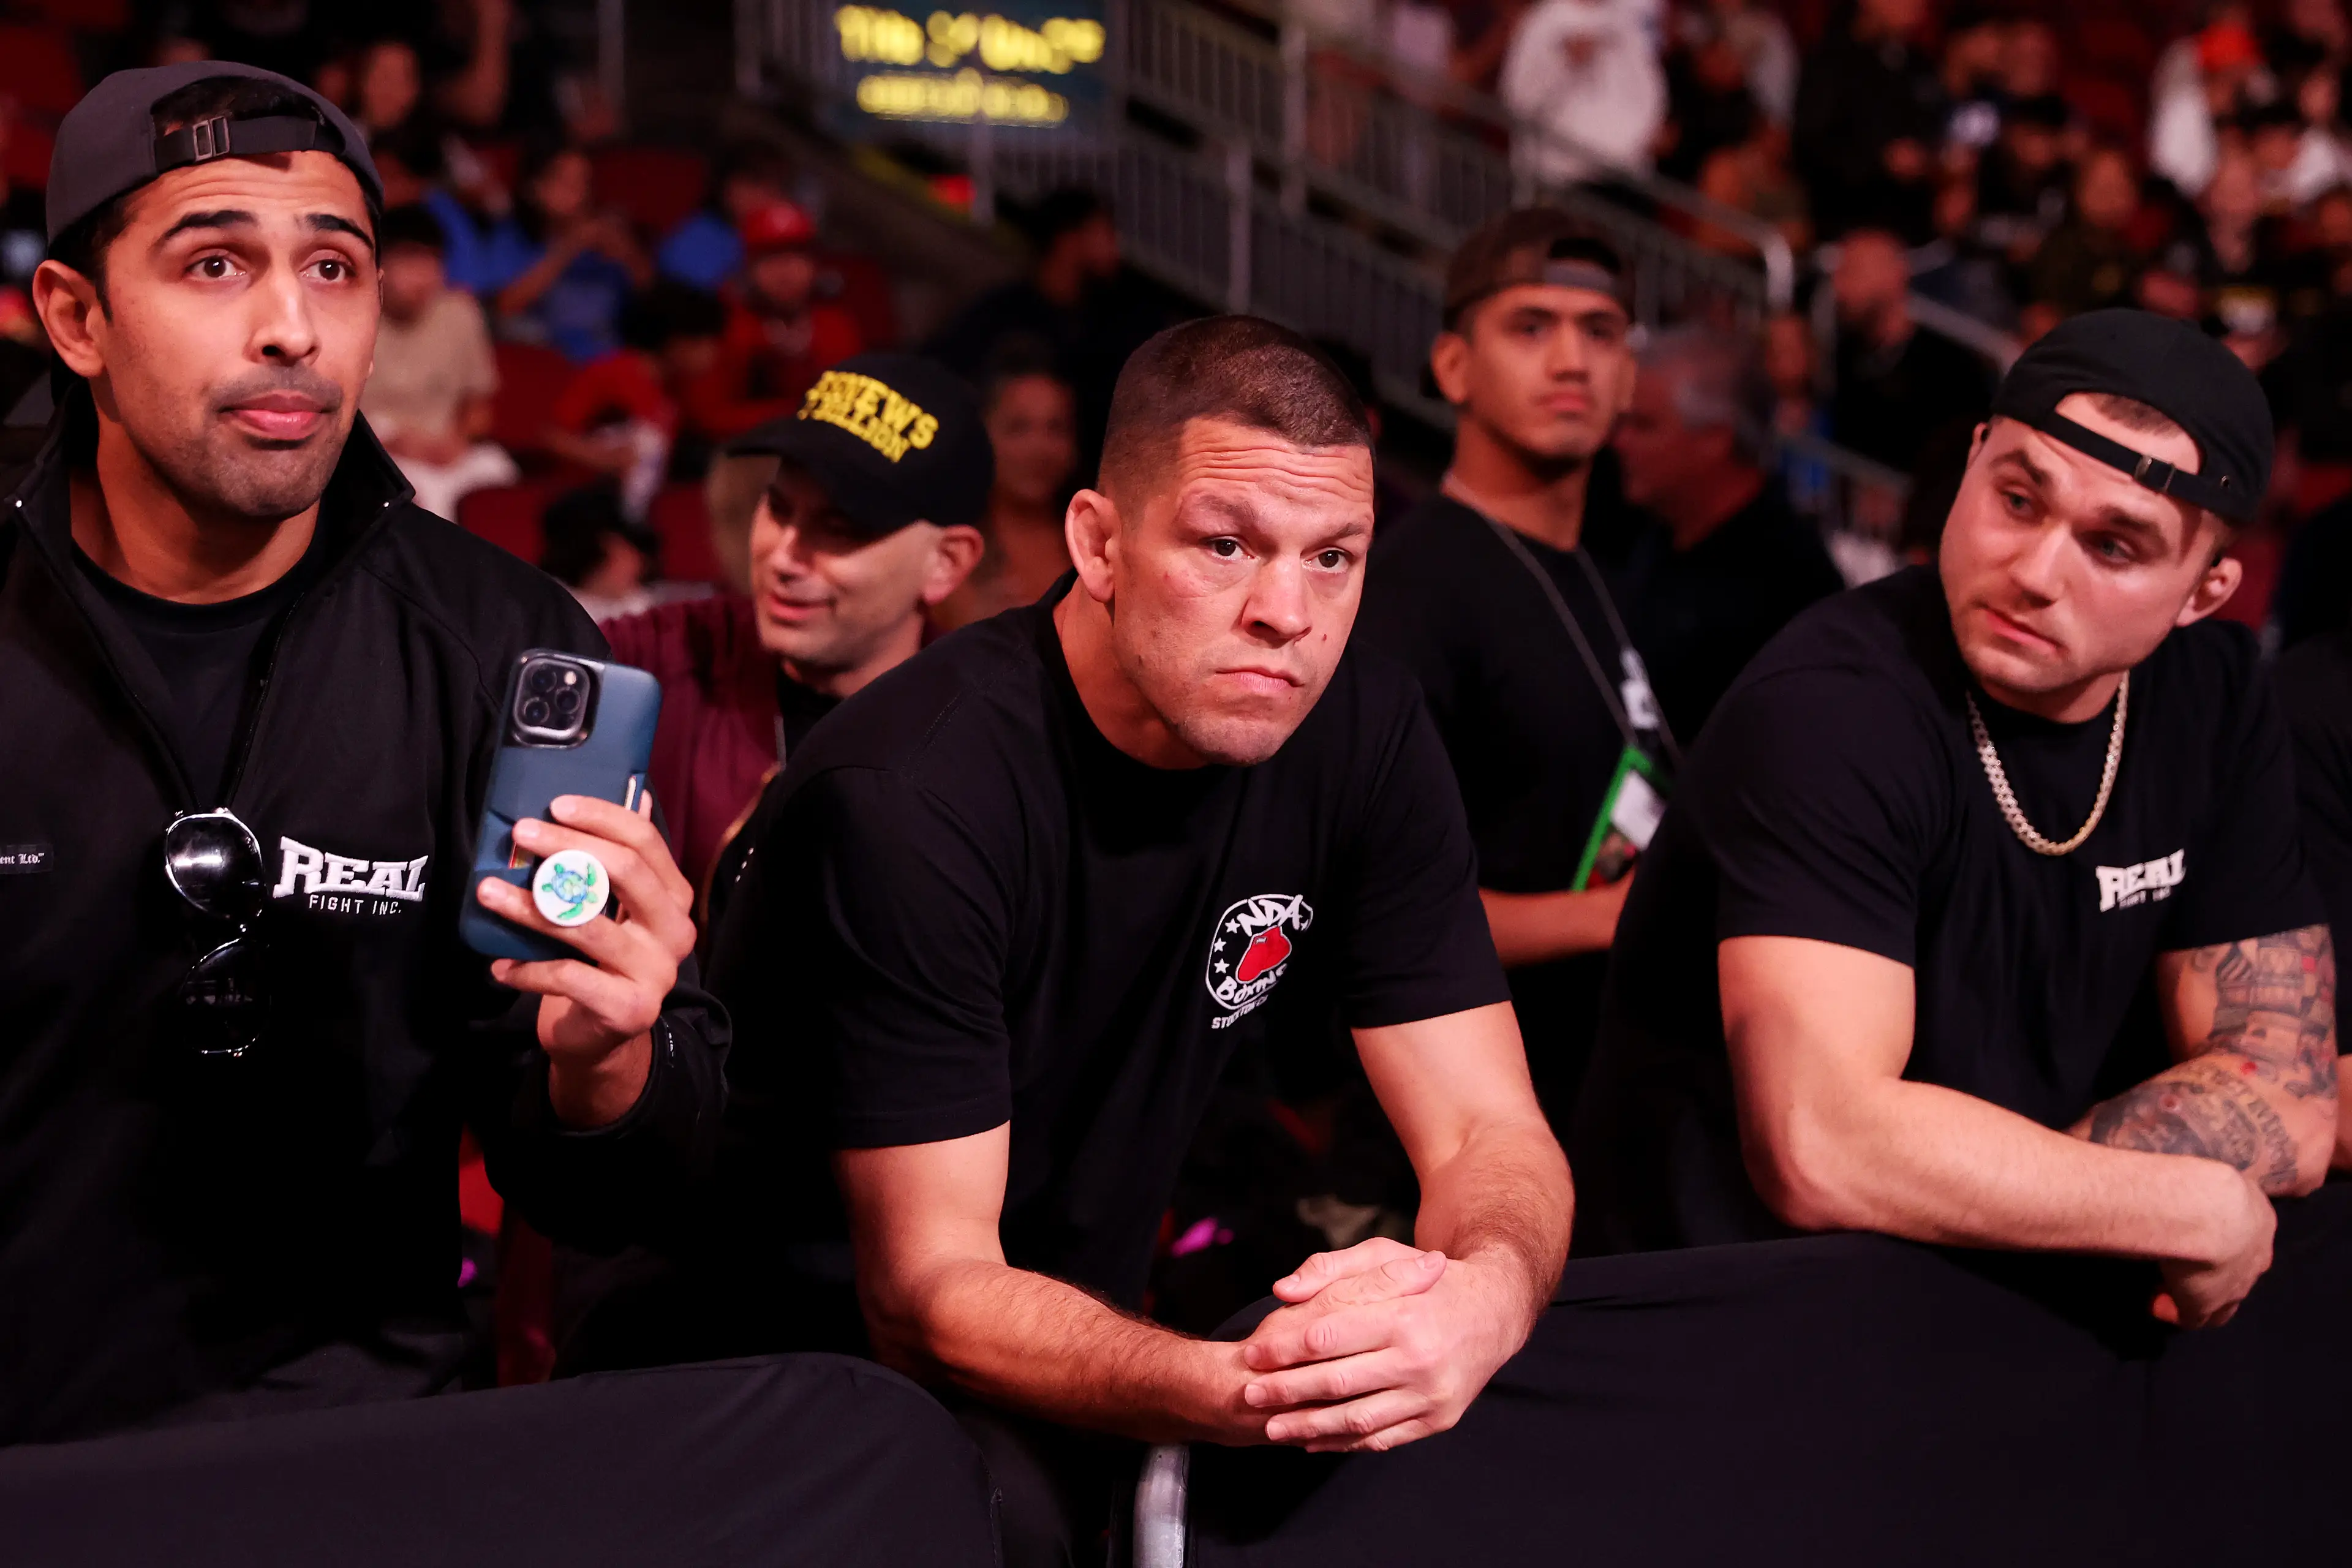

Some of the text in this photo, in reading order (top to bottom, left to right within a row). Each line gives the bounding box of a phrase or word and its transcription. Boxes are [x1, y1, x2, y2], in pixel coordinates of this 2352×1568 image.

[273, 835, 429, 902] REAL
[2095, 848, 2187, 913] REAL
[309, 895, 402, 916] FIGHT INC.
[1237, 894, 1303, 937] NDA
